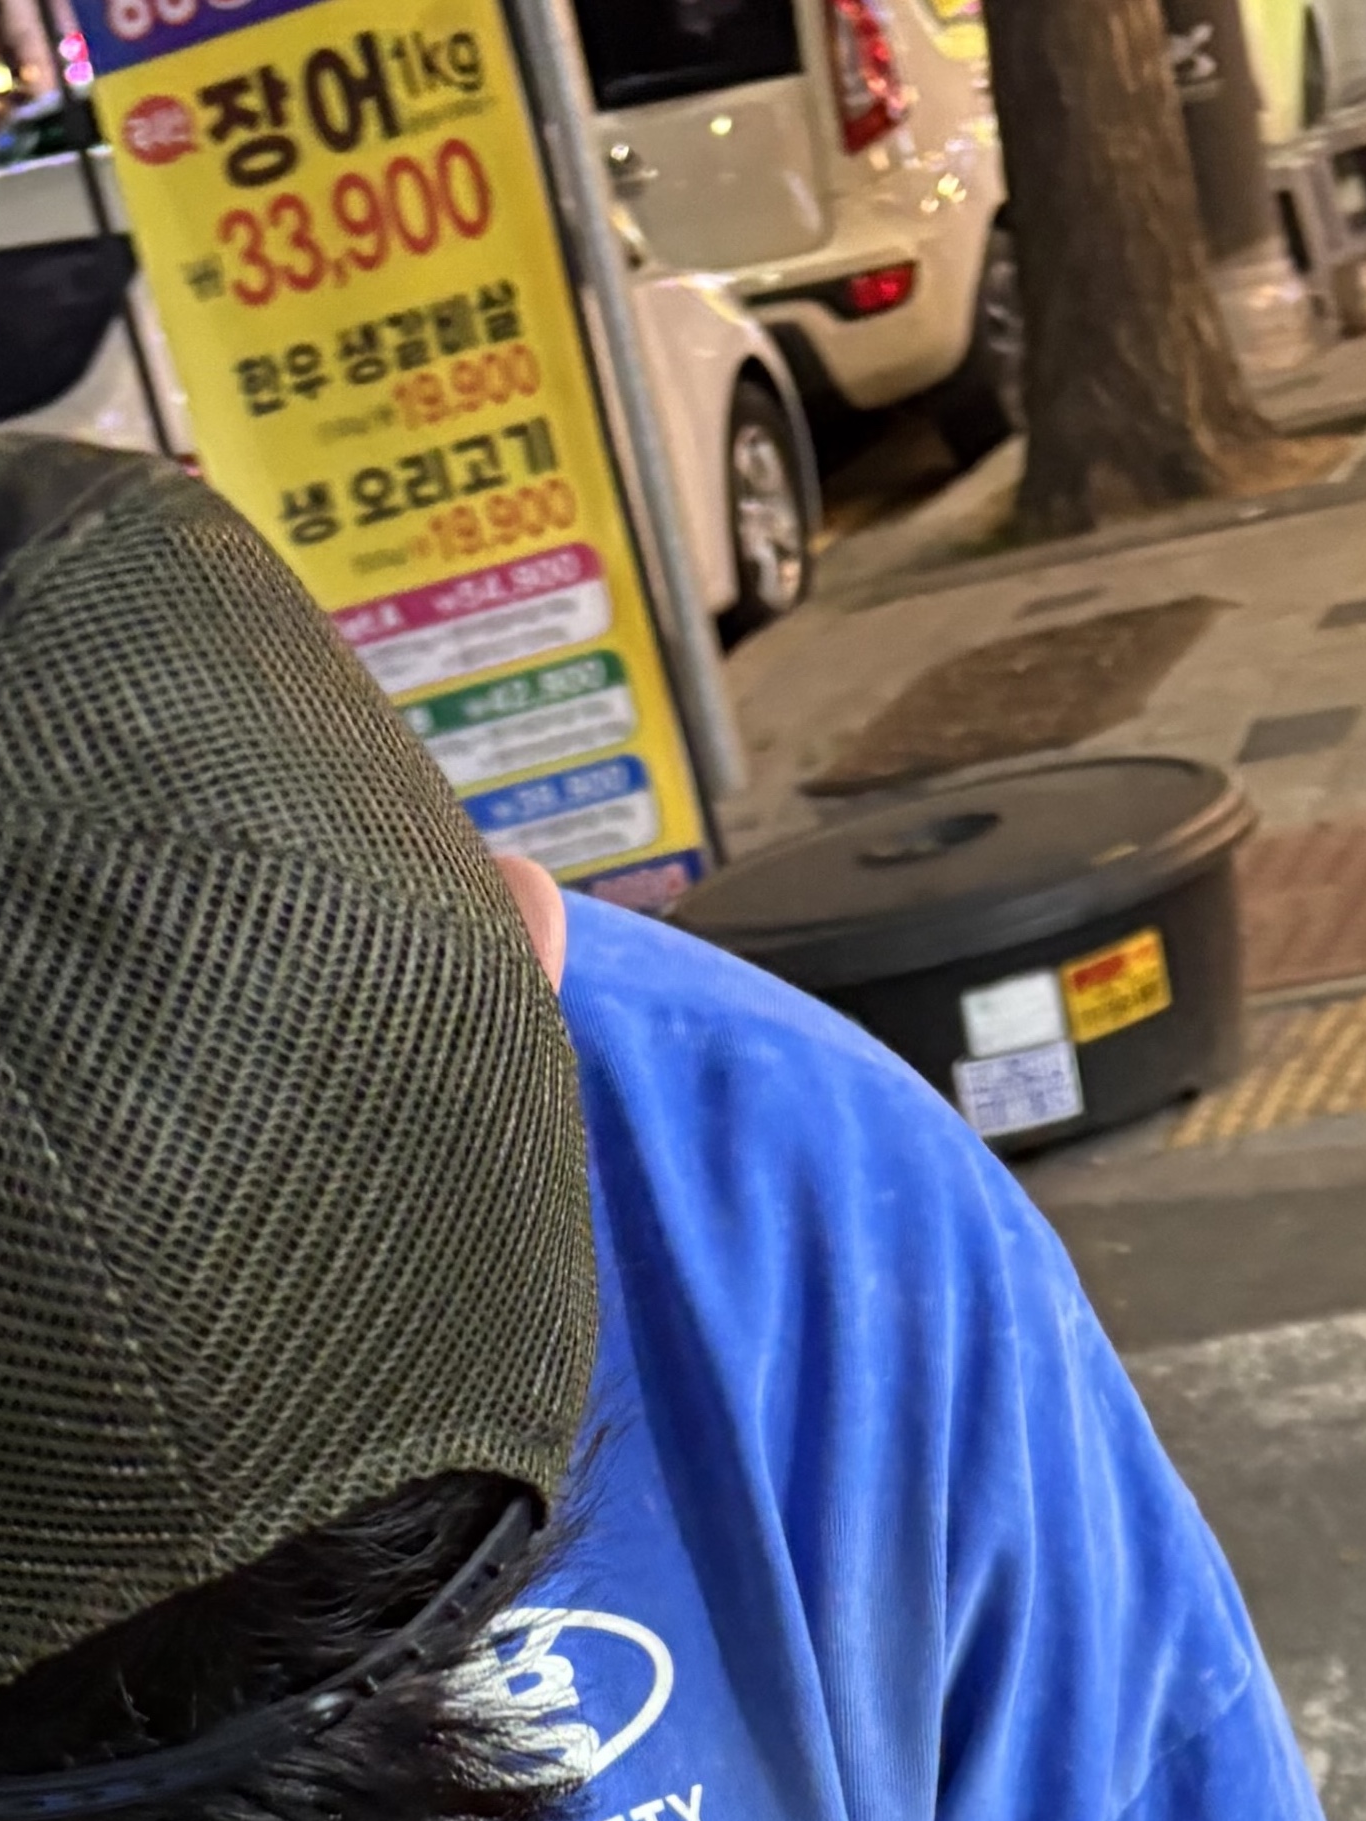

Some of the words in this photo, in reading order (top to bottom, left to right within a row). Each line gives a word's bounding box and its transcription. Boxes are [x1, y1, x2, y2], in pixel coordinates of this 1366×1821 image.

[196, 31, 402, 188] 장어
[390, 30, 486, 94] 1kg
[216, 137, 494, 307] 33,900
[233, 344, 330, 417] 한우
[350, 414, 560, 527] 오리고기
